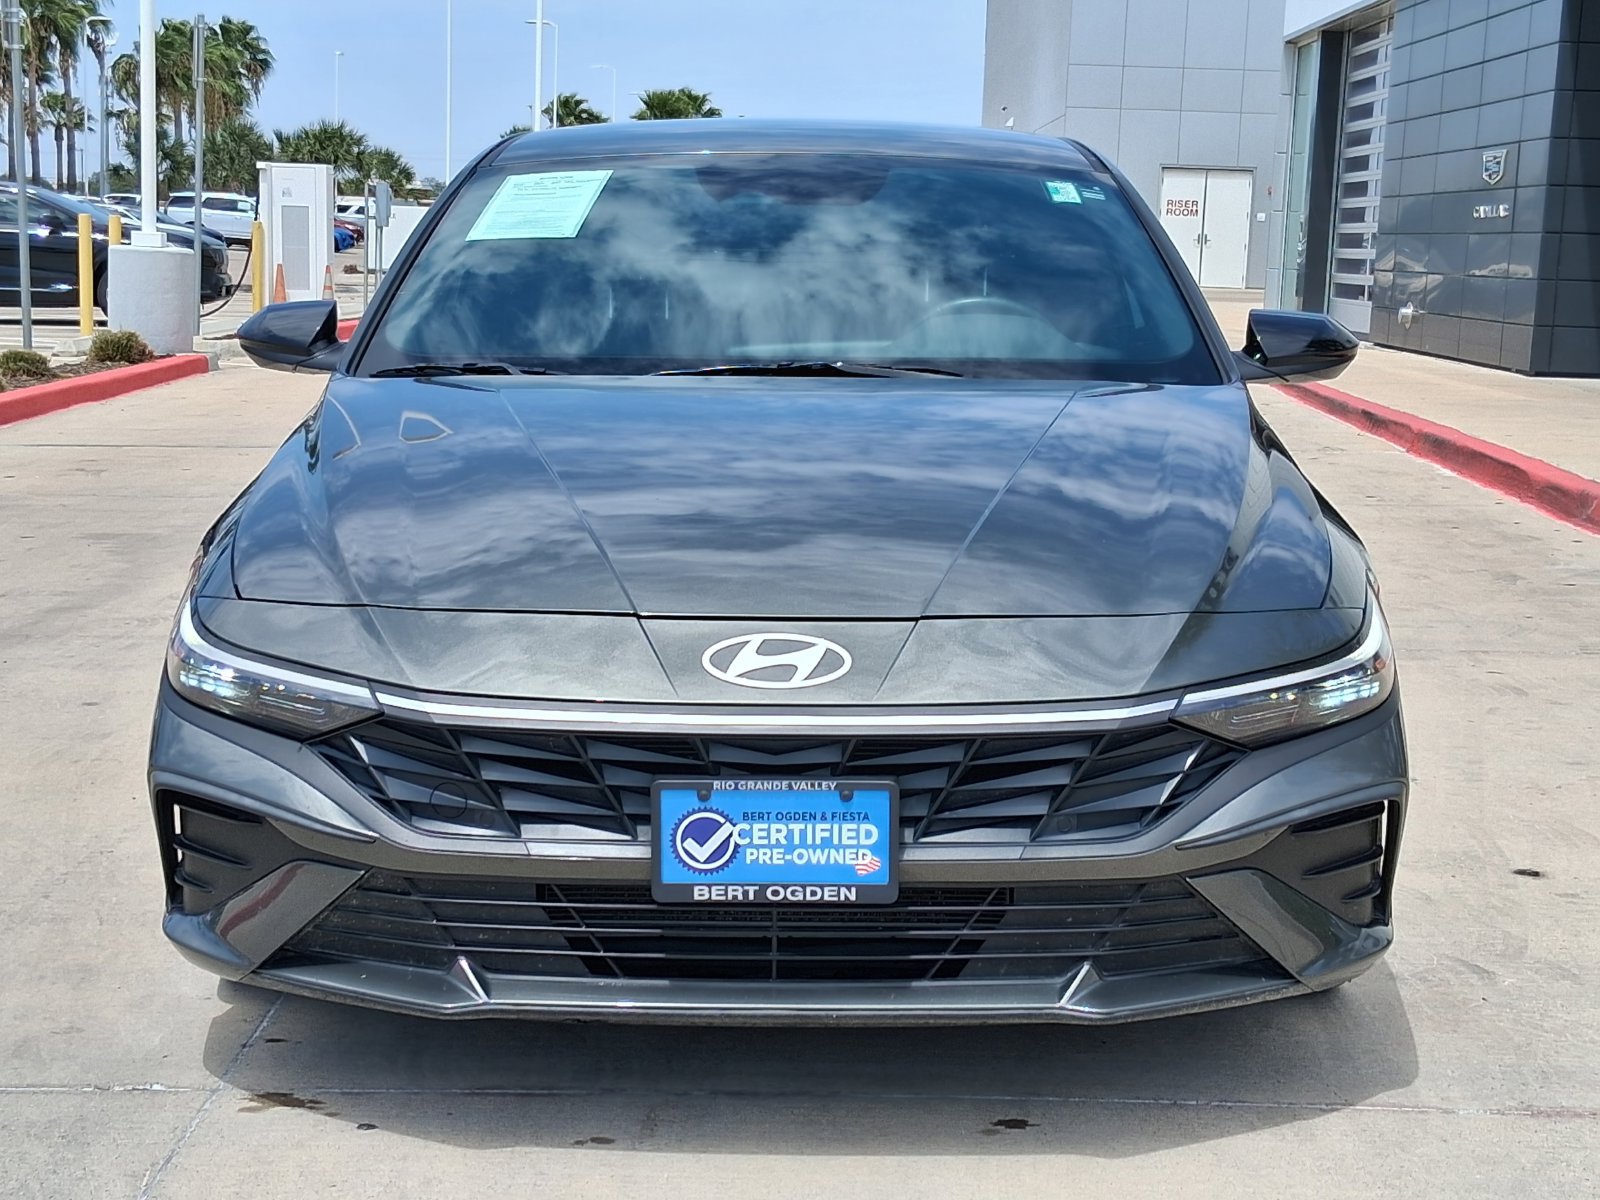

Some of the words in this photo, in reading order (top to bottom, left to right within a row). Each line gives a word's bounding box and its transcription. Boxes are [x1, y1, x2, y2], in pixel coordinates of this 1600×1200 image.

[1167, 199, 1199, 208] RISER
[1165, 208, 1199, 216] ROOM
[713, 781, 735, 791] RIO
[738, 781, 789, 791] GRANDE
[791, 781, 837, 791] VALLEY
[742, 812, 772, 821] BERT
[776, 812, 817, 821] OGDEN
[821, 812, 828, 821] &
[831, 812, 870, 821] FIESTA
[732, 823, 879, 845] CERTIFIED
[745, 848, 873, 865] PRE-OWNED
[693, 885, 760, 901] BERT
[765, 885, 857, 902] OGDEN
